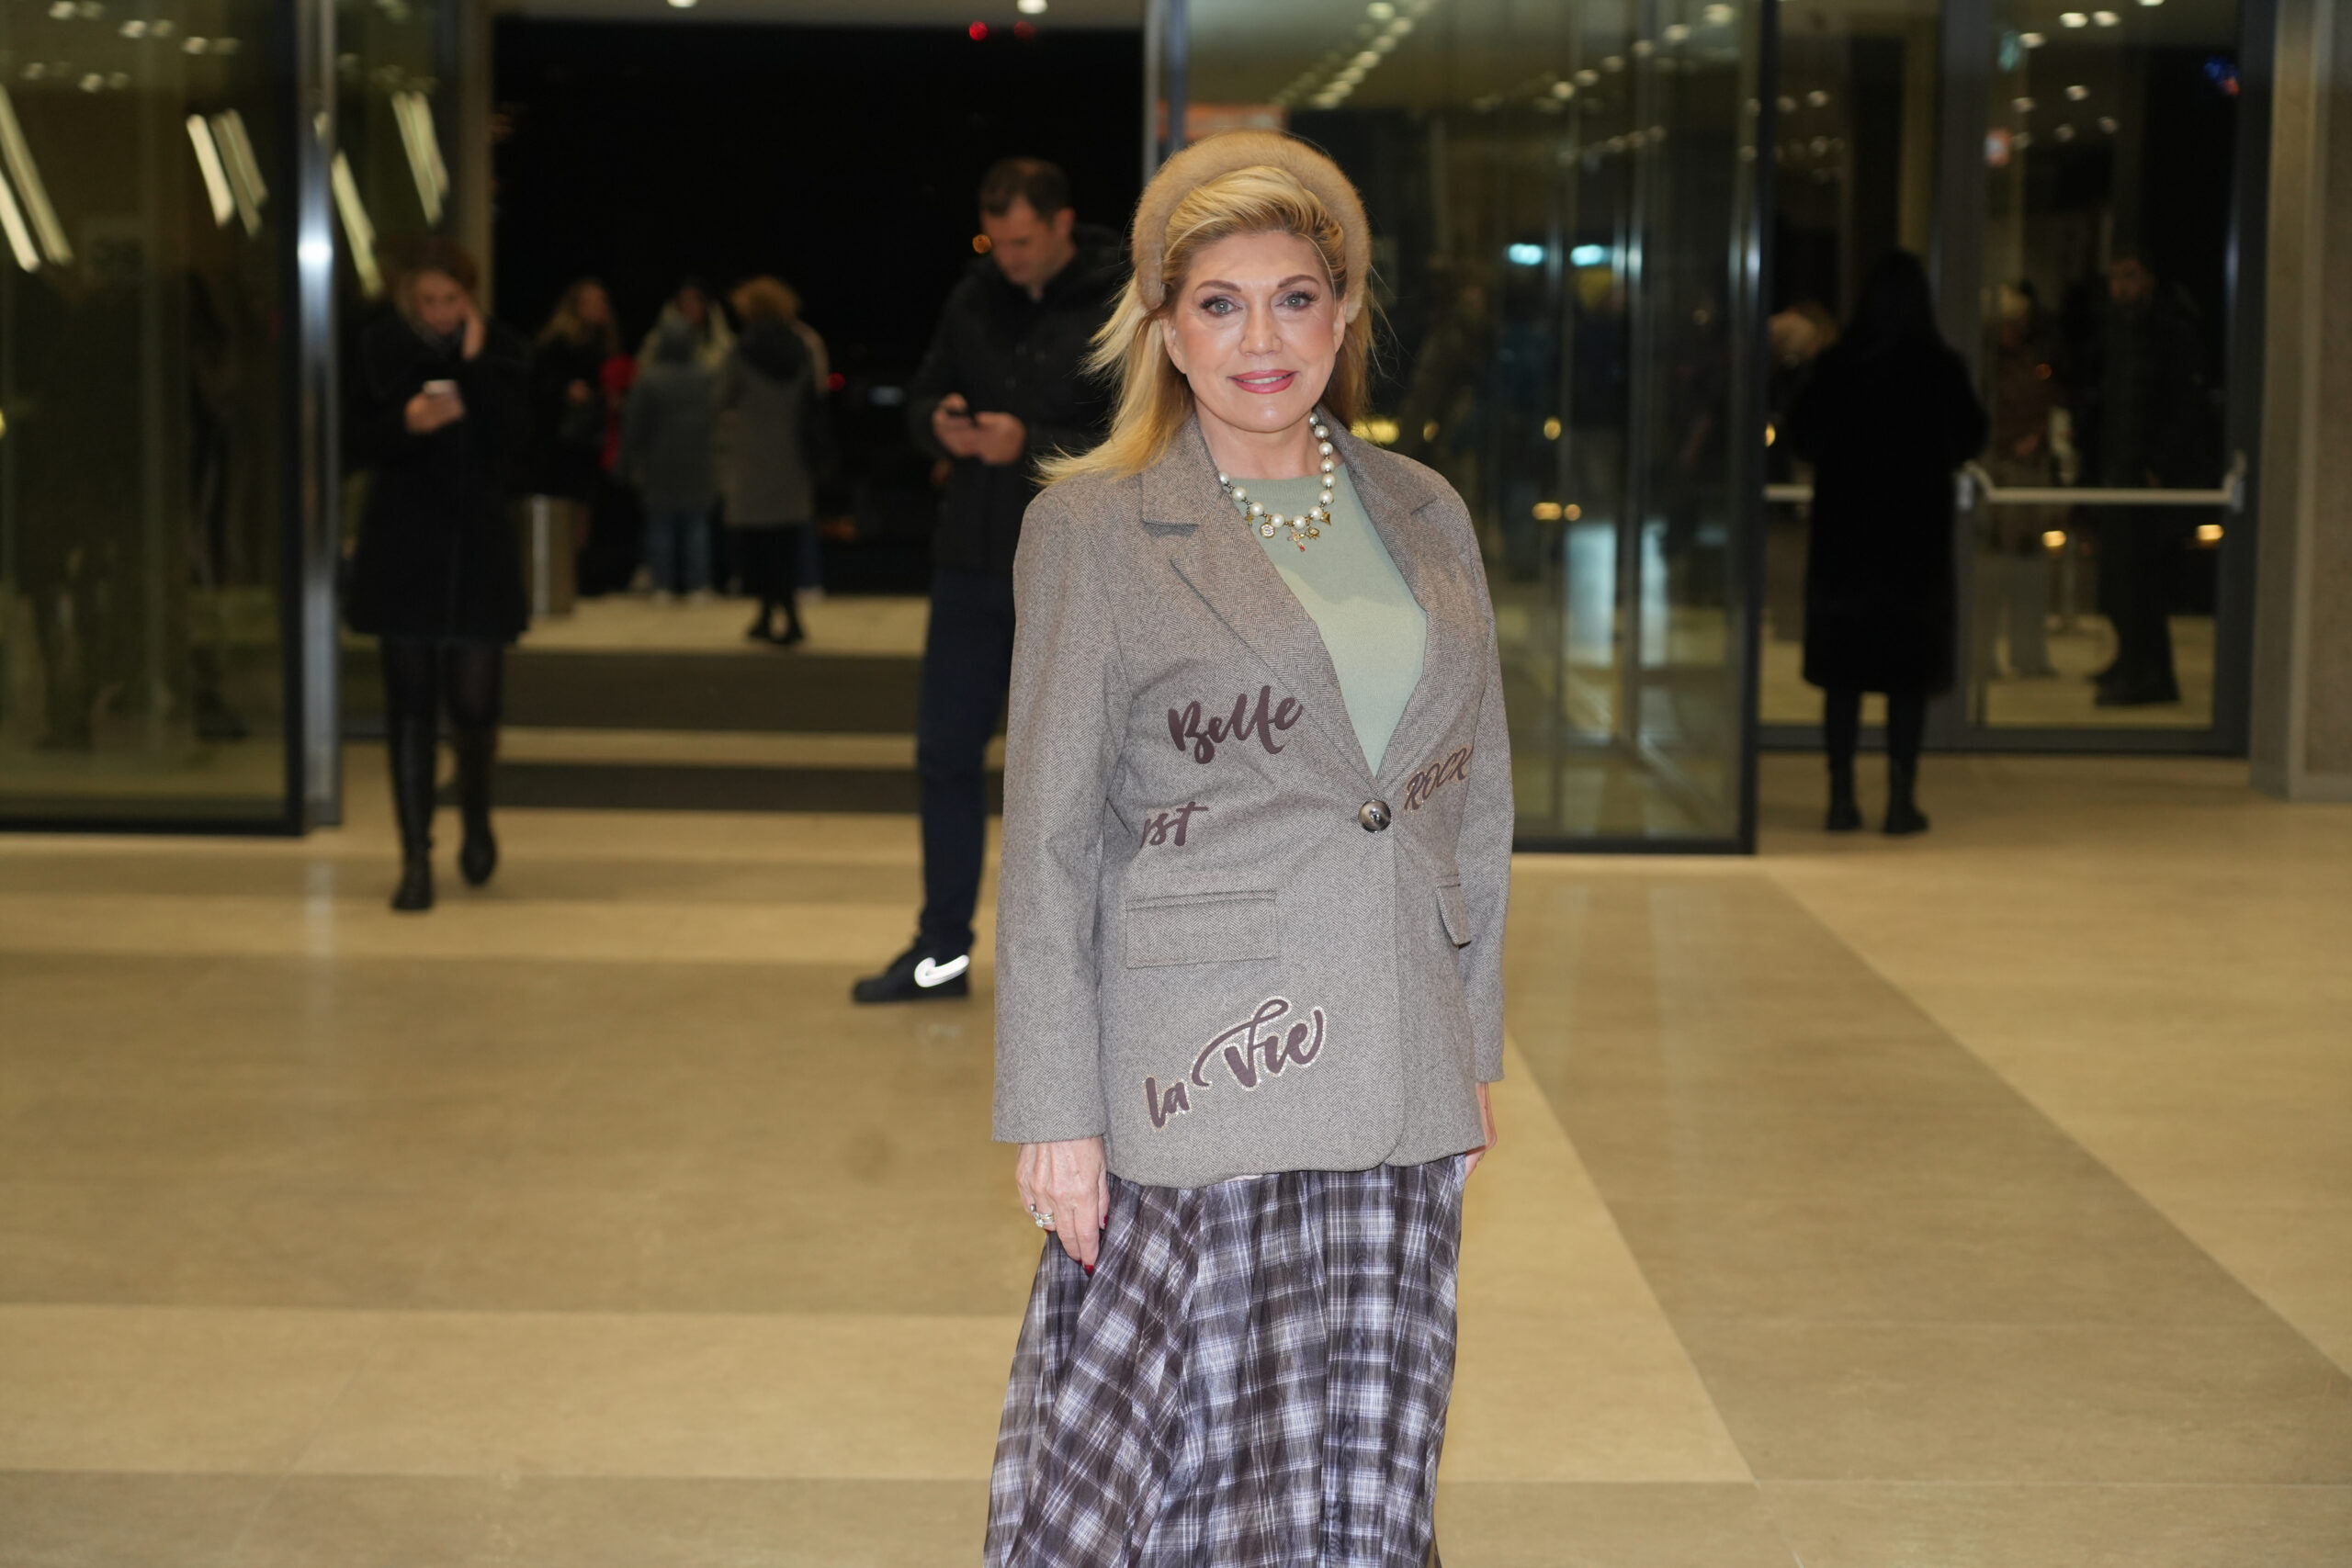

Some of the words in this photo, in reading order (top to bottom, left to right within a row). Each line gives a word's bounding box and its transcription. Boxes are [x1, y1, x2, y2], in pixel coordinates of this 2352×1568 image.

[1167, 684, 1305, 765] Belle
[1402, 746, 1475, 811] ROCK
[1144, 1076, 1191, 1130] la
[1192, 998, 1325, 1089] Vie
